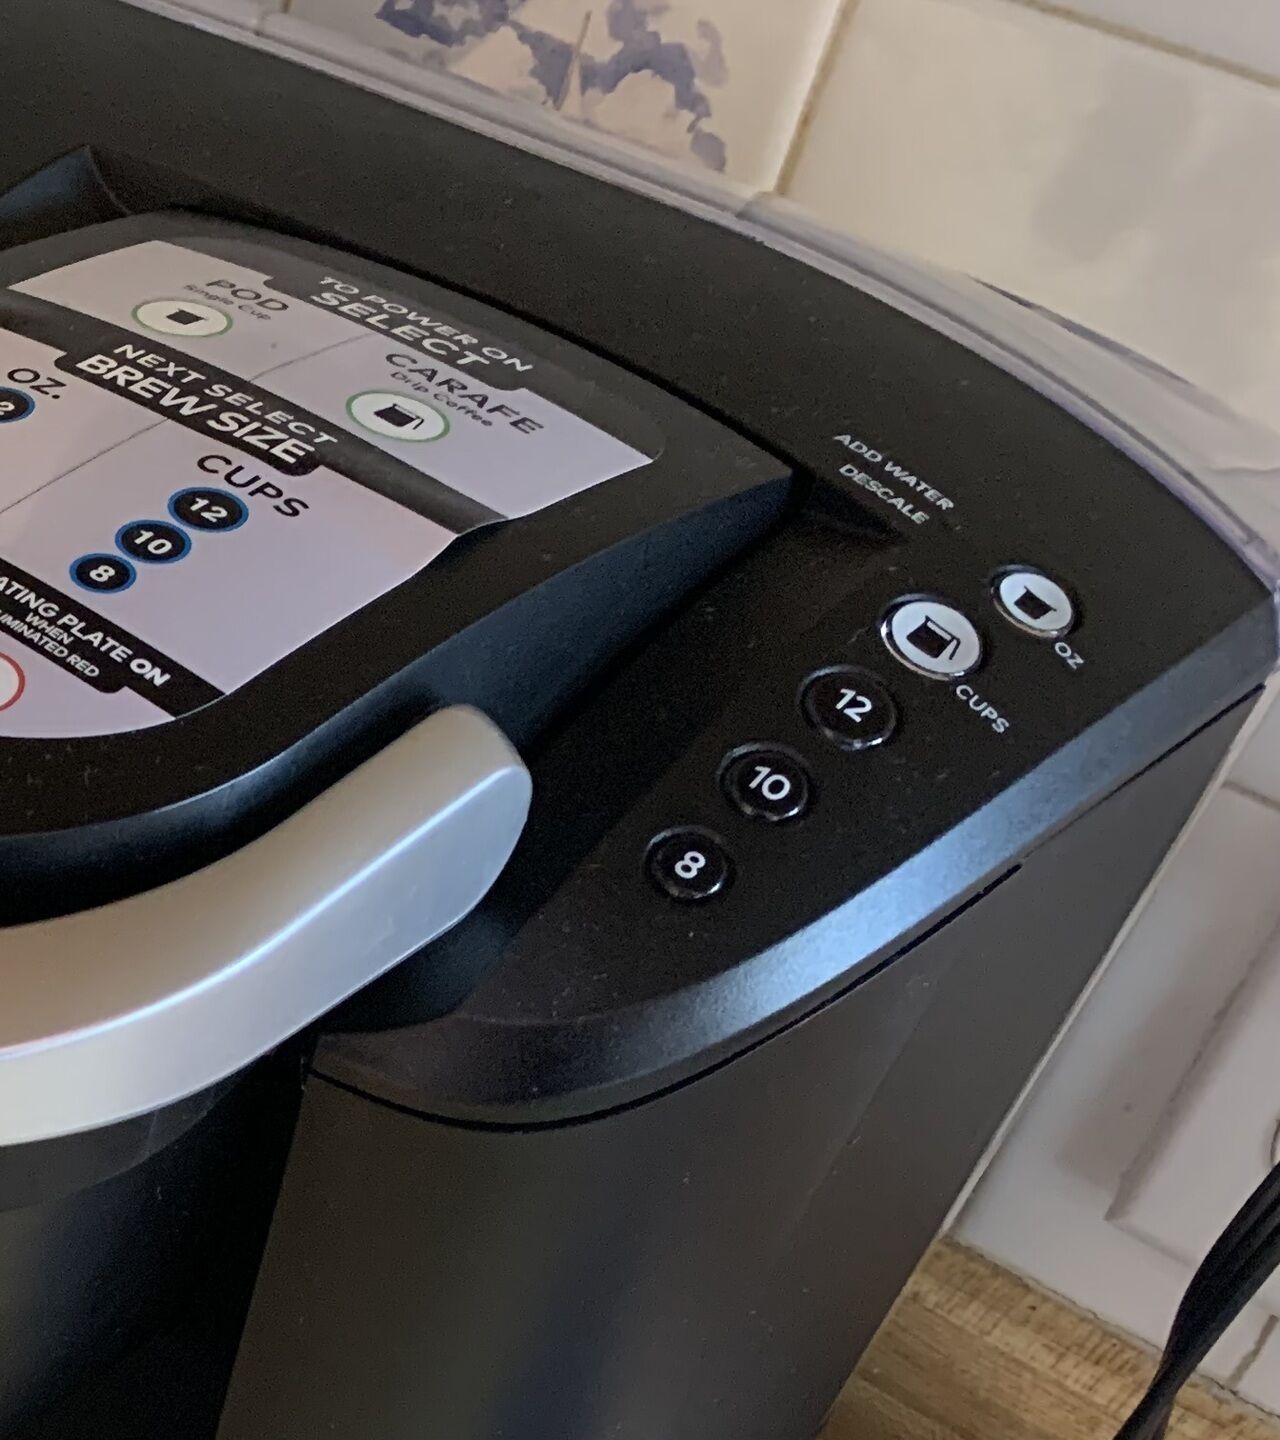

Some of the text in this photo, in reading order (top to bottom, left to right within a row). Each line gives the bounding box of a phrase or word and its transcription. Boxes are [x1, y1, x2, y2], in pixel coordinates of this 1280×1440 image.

[183, 284, 271, 321] Single Cup
[207, 279, 289, 311] POD
[309, 291, 490, 366] SELECT
[319, 276, 535, 373] TO POWER ON
[7, 368, 67, 400] OZ.
[114, 344, 337, 444] NEXT SELECT
[385, 353, 545, 434] CARAFE
[390, 370, 493, 427] Drip Coffee
[75, 354, 316, 464] BREW SIZE
[197, 455, 310, 517] CUPS
[834, 434, 954, 511] ADD WATER
[190, 497, 228, 523] 12
[839, 463, 929, 525] DESCALE
[134, 530, 172, 554] 10
[89, 565, 115, 583] 8
[25, 612, 74, 645] WHEN
[57, 614, 133, 663] PLATE
[130, 659, 171, 687] ON
[65, 655, 100, 678] RED
[1053, 642, 1084, 670] OZ
[835, 689, 871, 722] 12
[956, 685, 1010, 734] CUPS
[748, 765, 791, 800] 10
[675, 850, 706, 879] 8
